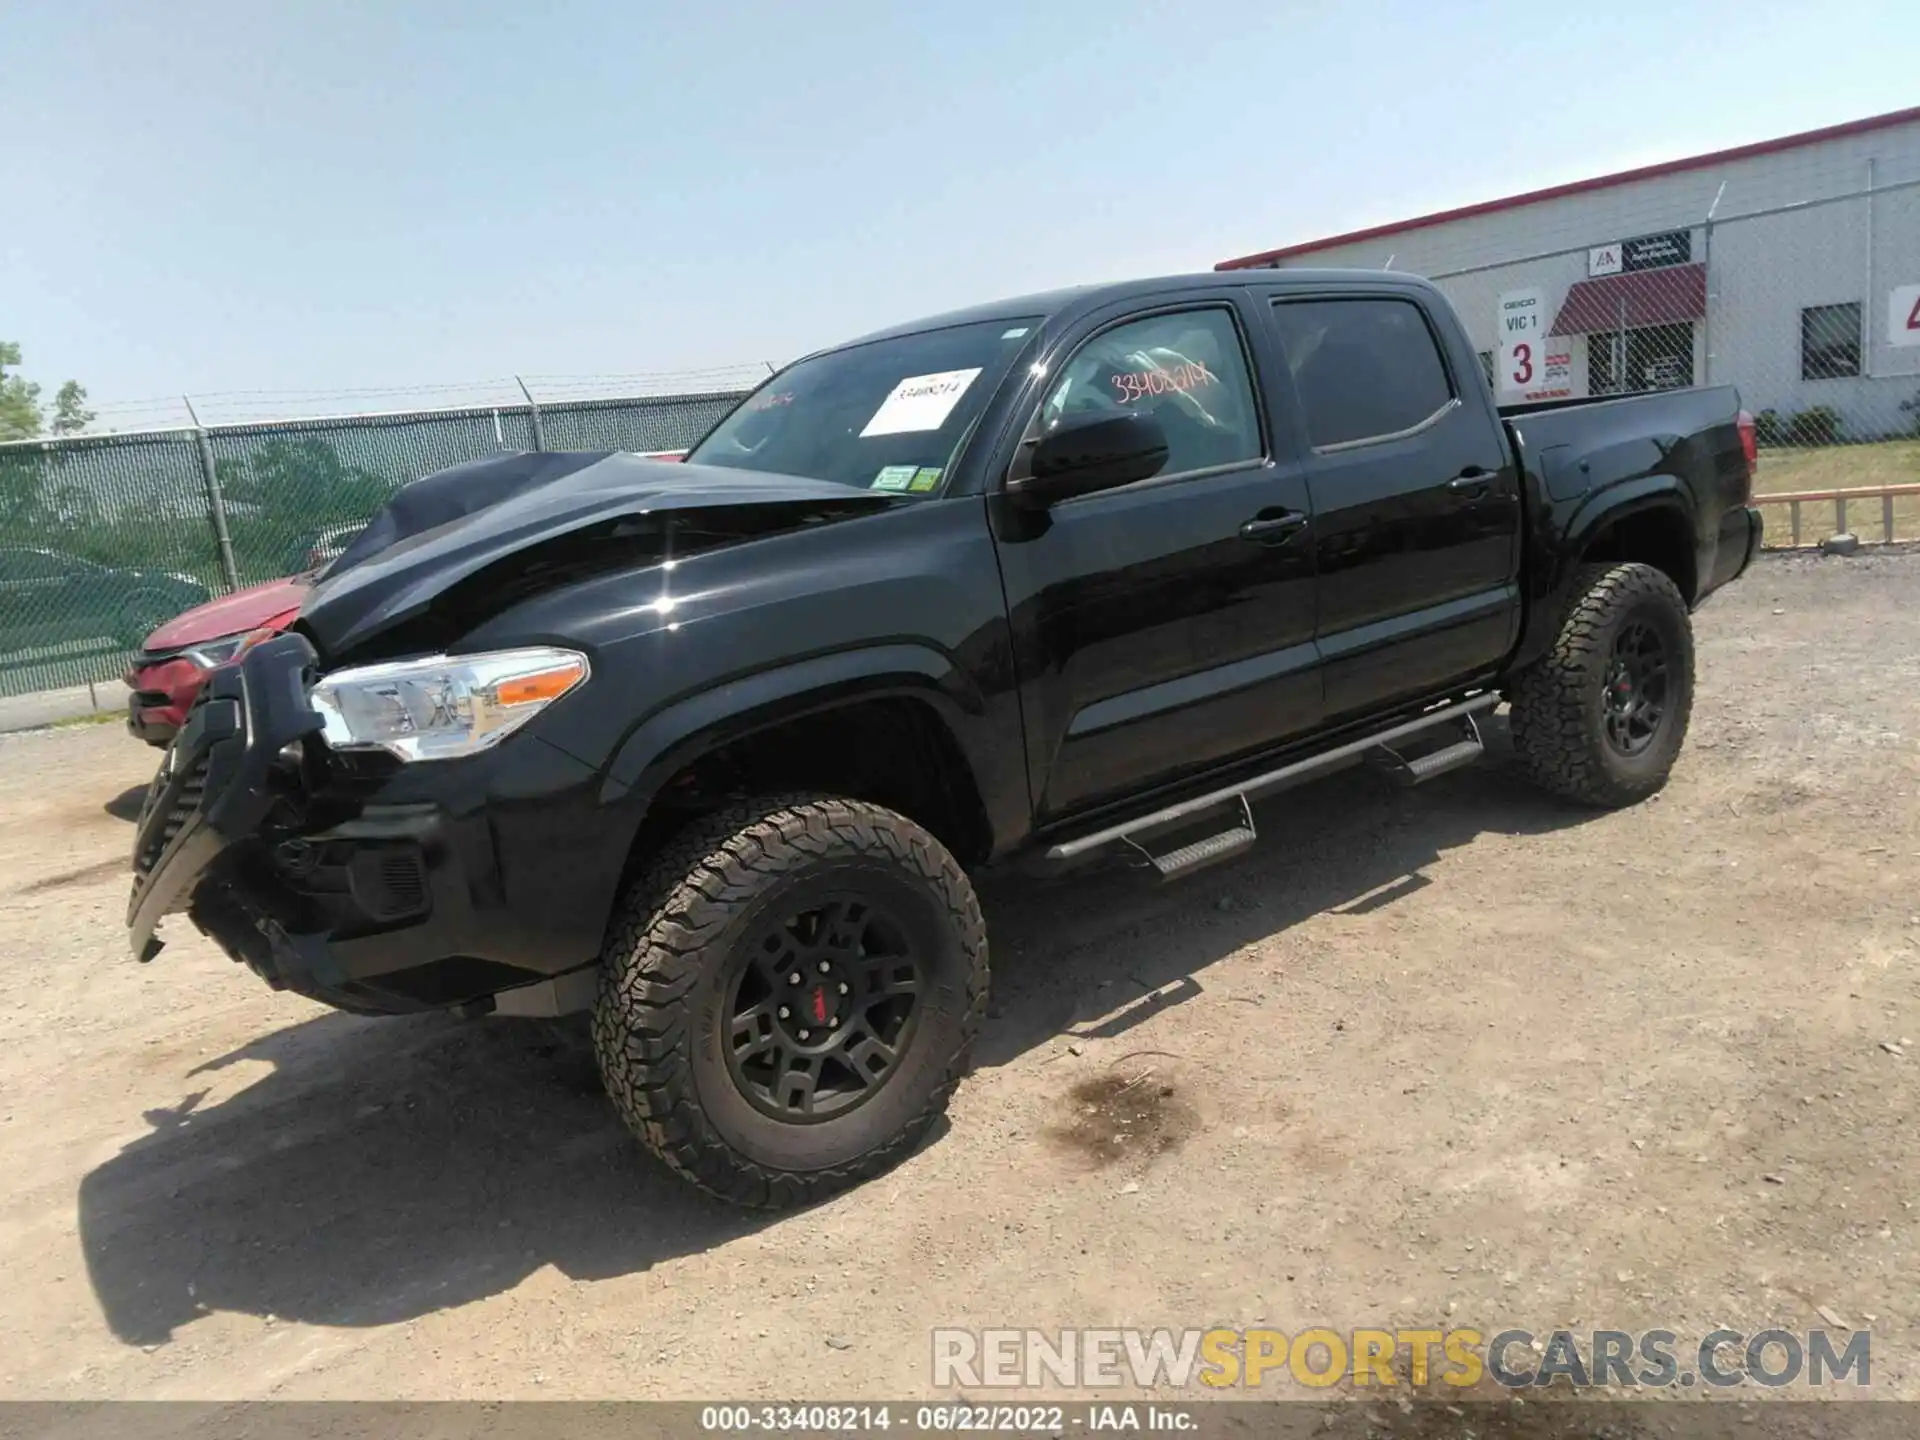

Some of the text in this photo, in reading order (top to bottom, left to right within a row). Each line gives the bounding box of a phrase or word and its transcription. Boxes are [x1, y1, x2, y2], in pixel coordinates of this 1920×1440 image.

[1506, 314, 1537, 331] VIC 1
[1513, 343, 1533, 384] 3
